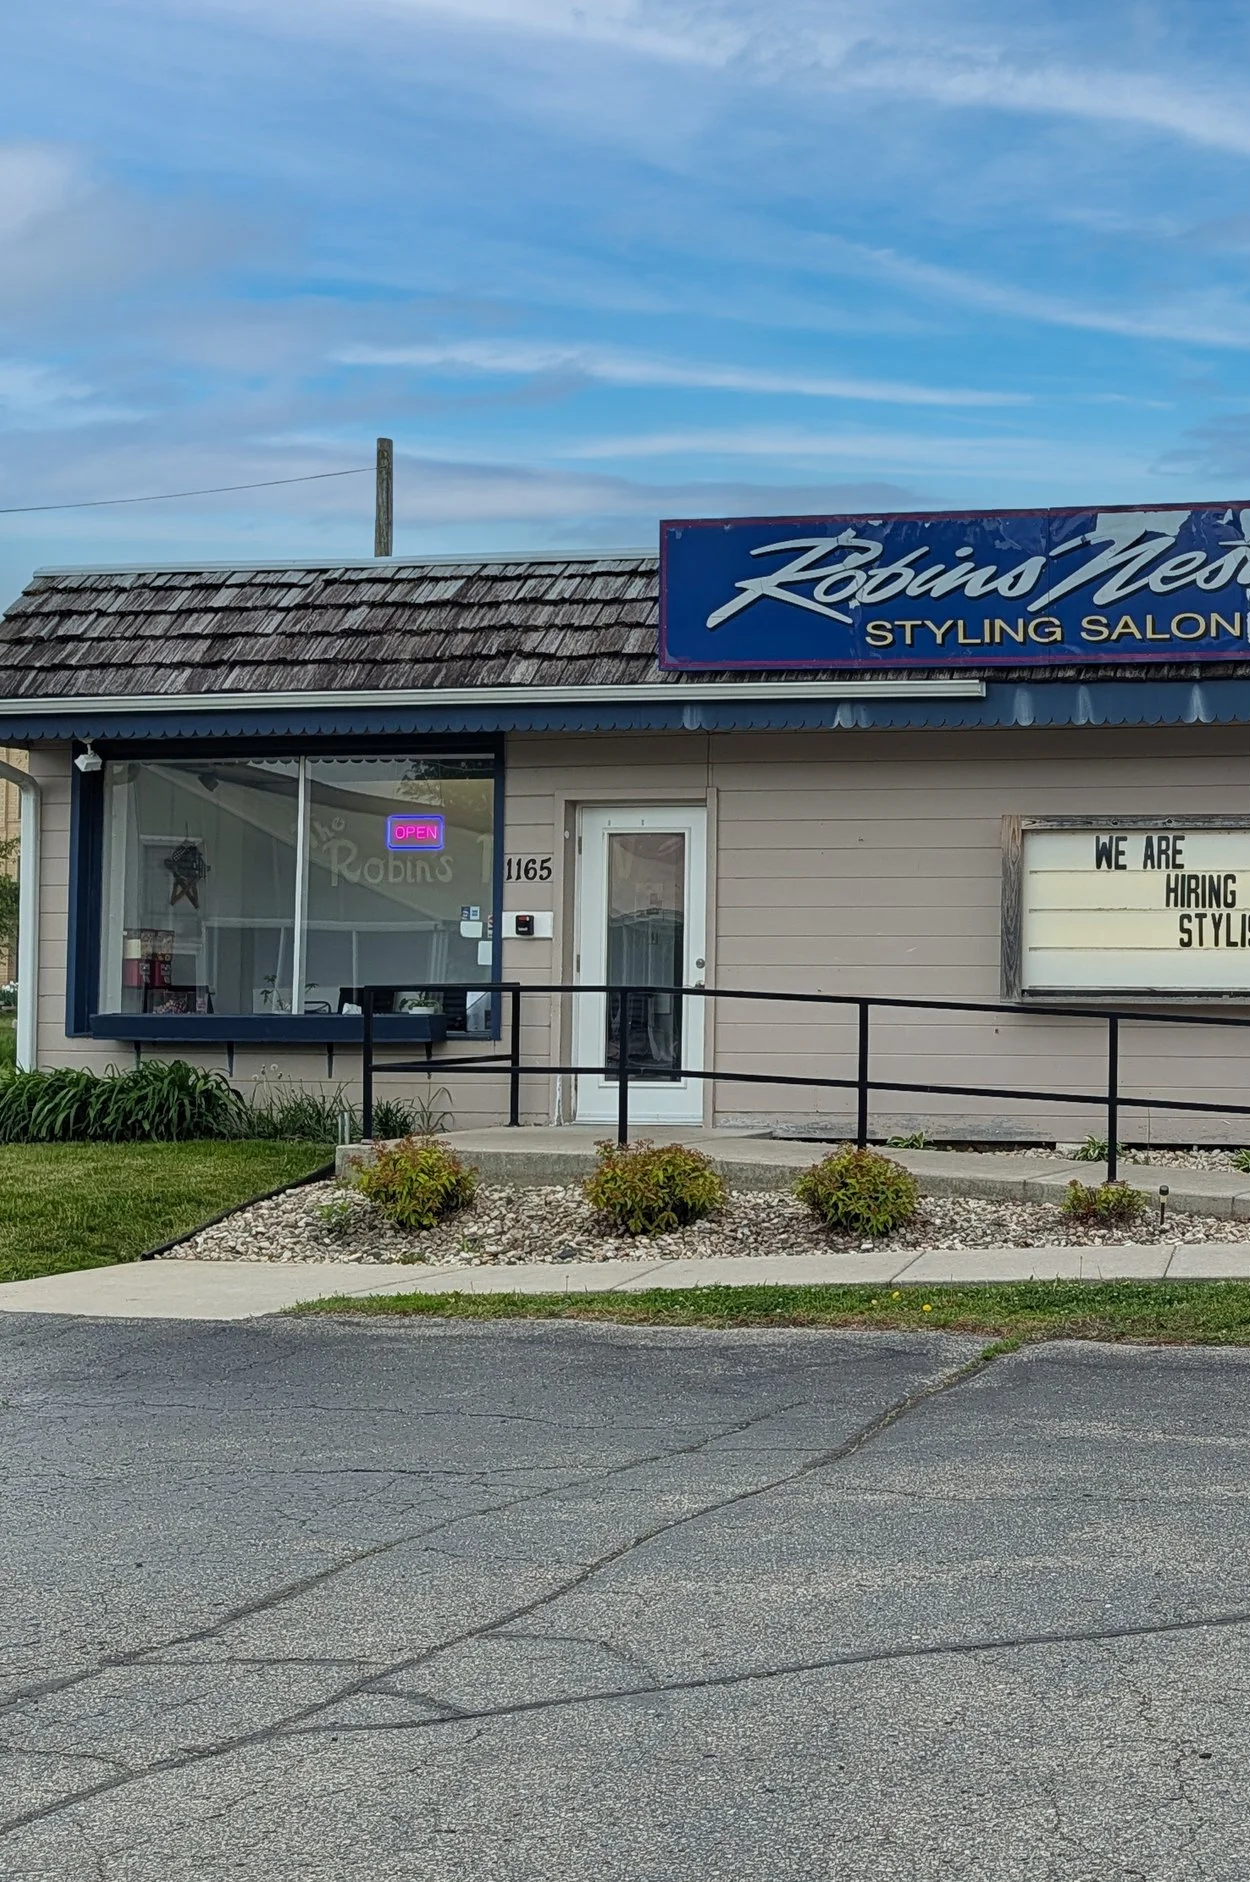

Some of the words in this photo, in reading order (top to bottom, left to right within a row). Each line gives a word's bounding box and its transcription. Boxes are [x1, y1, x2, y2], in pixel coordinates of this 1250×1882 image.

[864, 616, 1062, 646] STYLING
[1080, 611, 1241, 641] SALON
[395, 825, 437, 840] OPEN
[506, 857, 552, 881] 1165
[1095, 835, 1128, 870] WE
[1143, 835, 1185, 870] ARE
[1165, 873, 1236, 909] HIRING
